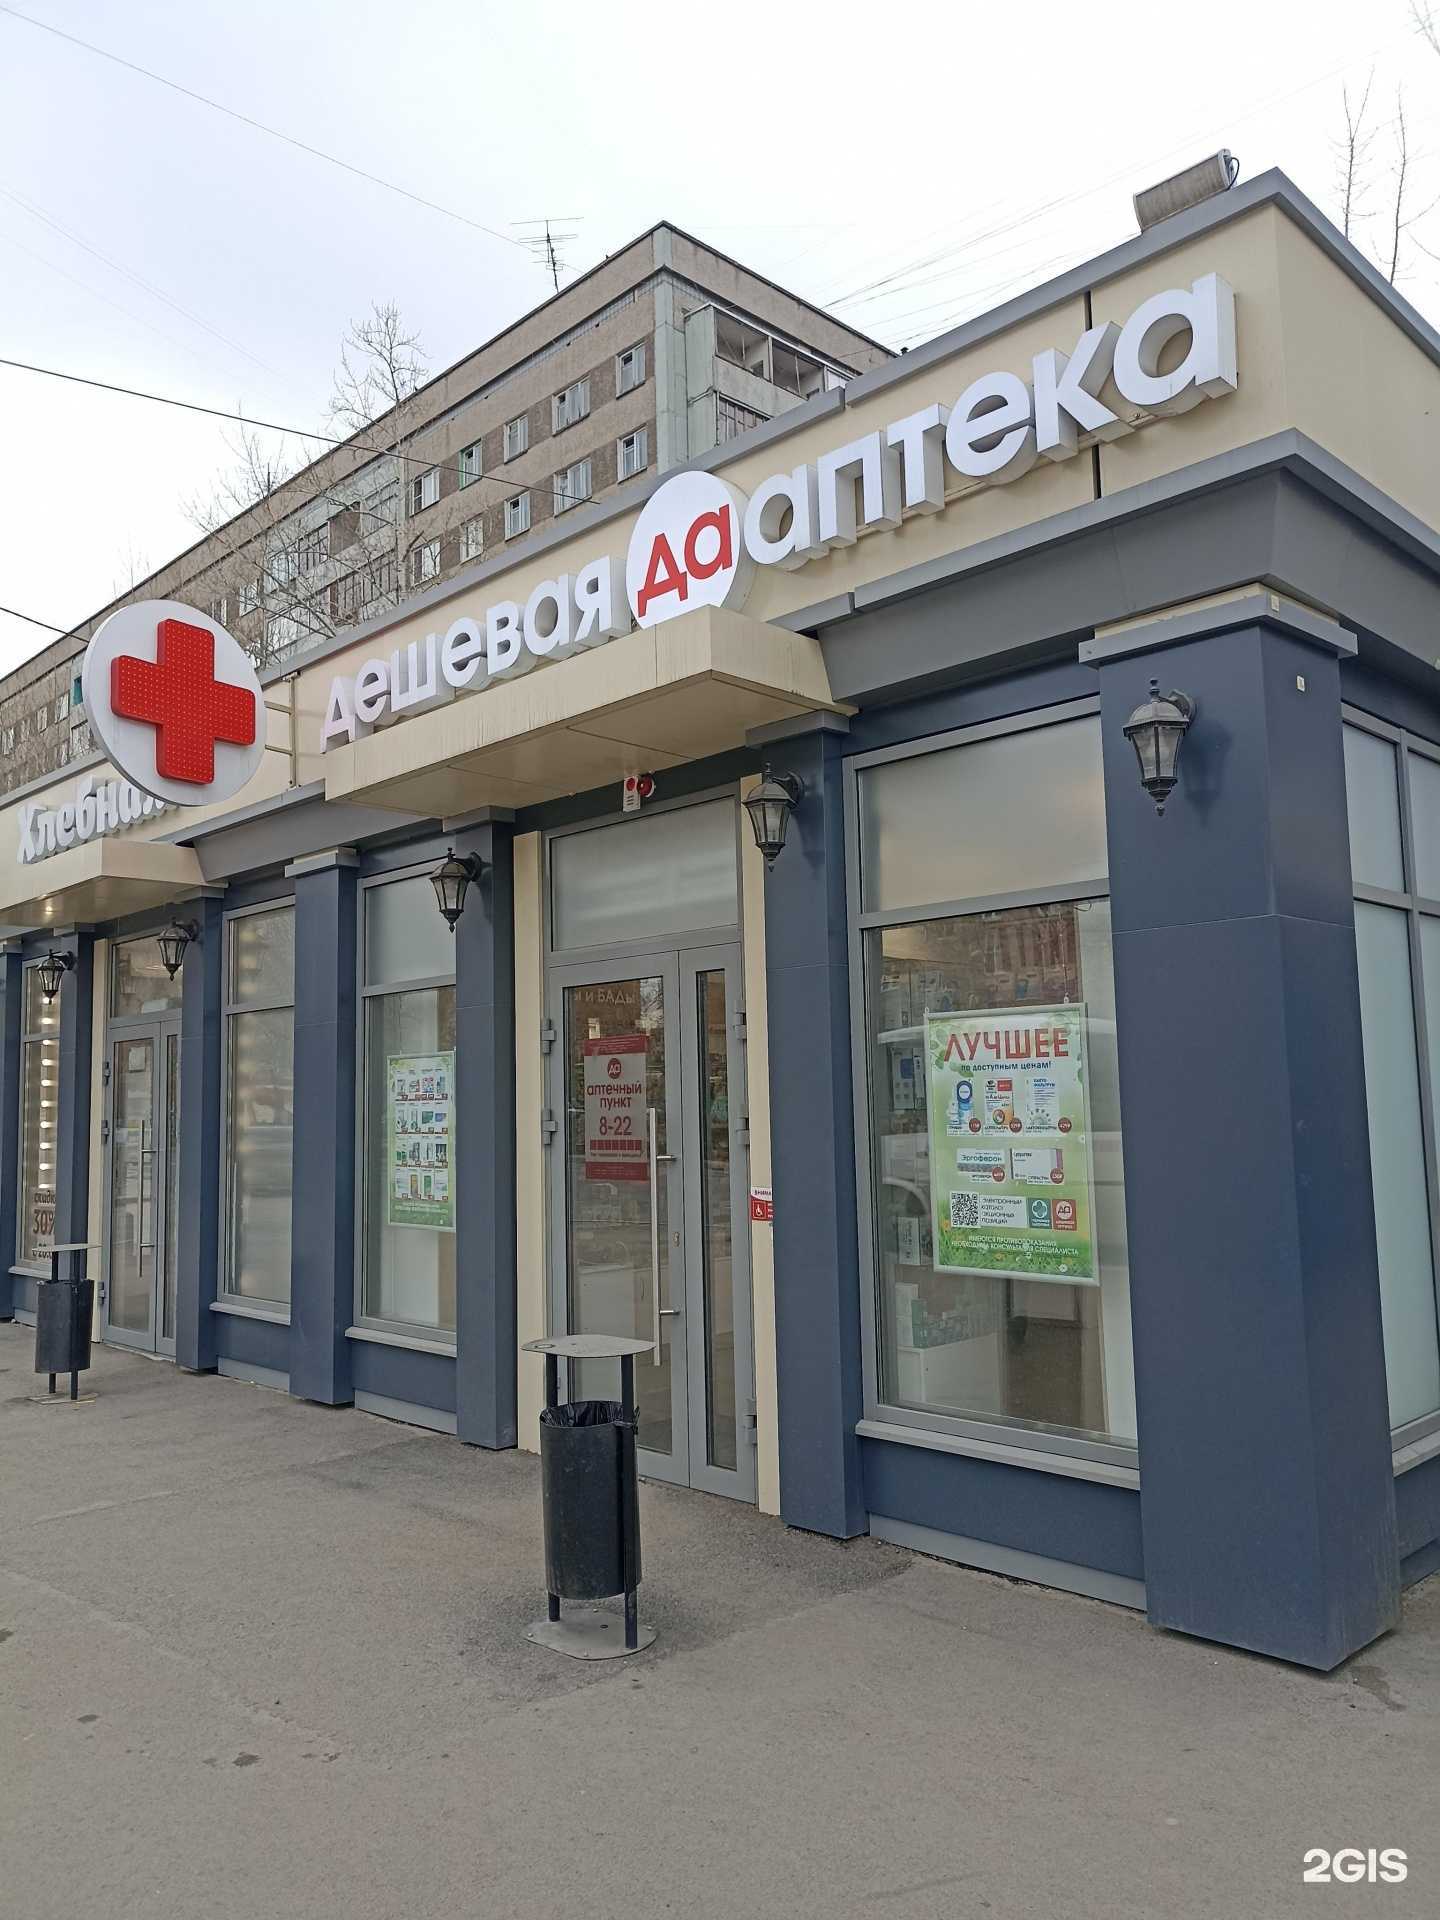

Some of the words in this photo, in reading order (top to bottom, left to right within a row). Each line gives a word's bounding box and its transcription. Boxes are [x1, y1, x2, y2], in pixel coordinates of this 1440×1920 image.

[744, 272, 1237, 568] аптека
[944, 1027, 1069, 1062] ЛУЧШЕЕ
[961, 1064, 971, 1072] по
[972, 1063, 1018, 1072] доступным
[1020, 1061, 1052, 1071] ценам!
[587, 1080, 642, 1097] аптечный
[600, 1096, 633, 1111] пункт
[599, 1115, 633, 1136] 8-22
